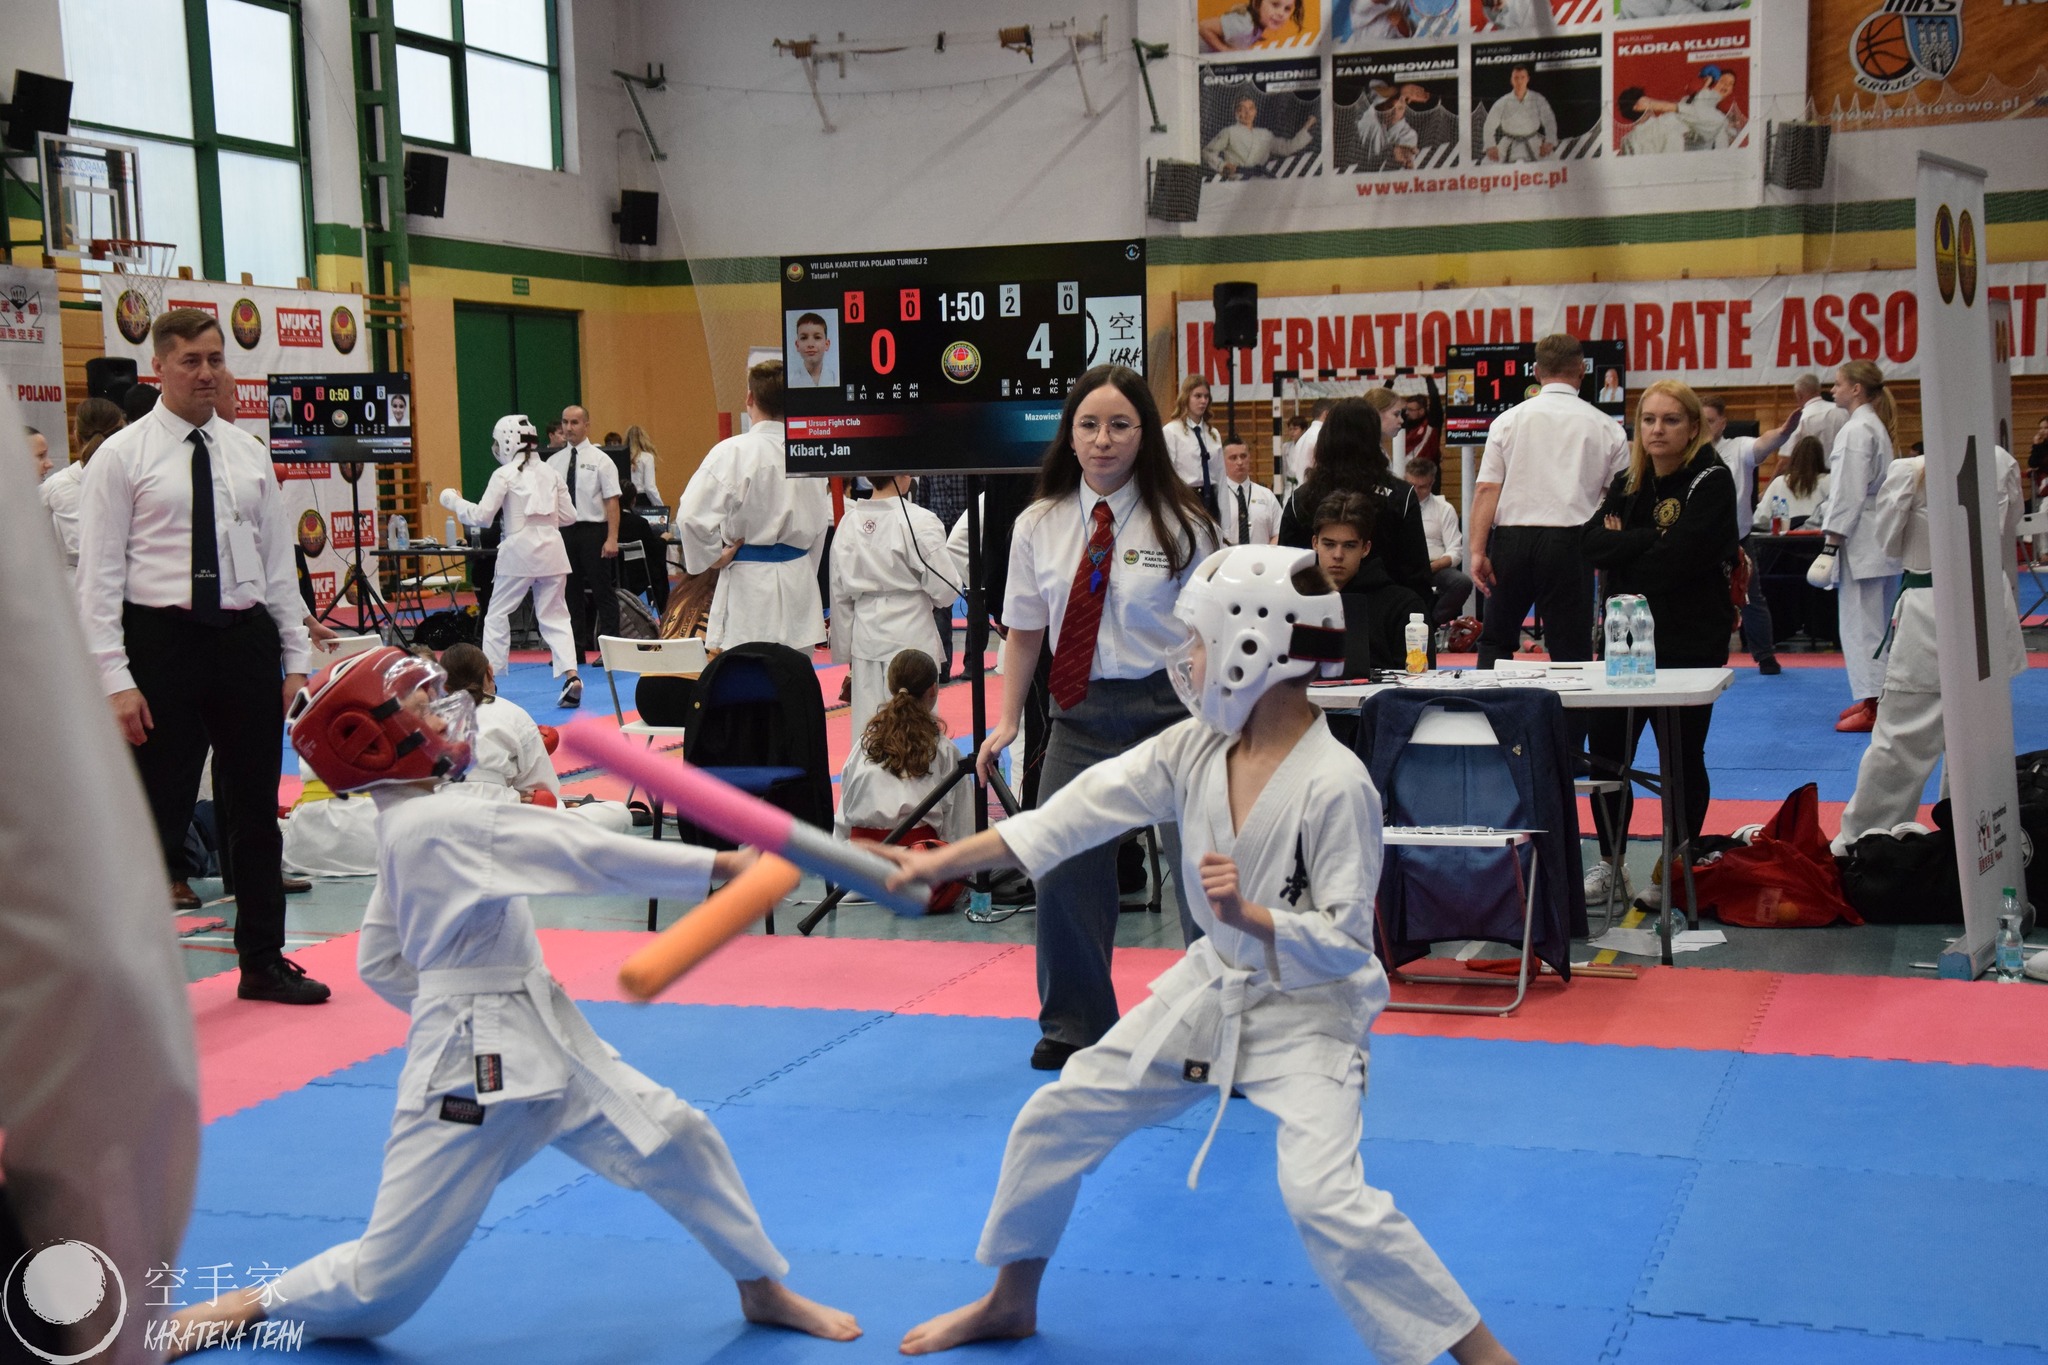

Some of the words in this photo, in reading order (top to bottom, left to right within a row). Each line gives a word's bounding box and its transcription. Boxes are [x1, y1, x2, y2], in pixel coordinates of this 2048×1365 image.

[1617, 41, 1681, 57] KADRA
[1683, 35, 1746, 51] KLUBU
[1336, 59, 1456, 77] ZAAWANSOWANI
[1831, 96, 2020, 122] www.parkietowo.pl
[1356, 166, 1569, 197] www.karategrojec.pl
[811, 262, 819, 270] VII
[835, 260, 858, 269] KARATE
[859, 260, 870, 268] IKA
[871, 259, 896, 267] POLAND
[897, 258, 923, 266] TURNIEJ
[923, 257, 928, 265] 2
[811, 272, 830, 280] Tatami
[850, 302, 859, 320] 0
[905, 300, 916, 318] 0
[938, 291, 985, 322] 1:50
[1005, 296, 1015, 314] 2
[1063, 293, 1074, 311] 0
[279, 312, 320, 330] WUKF
[871, 329, 896, 375] 0
[1026, 323, 1053, 369] 4
[1109, 346, 1141, 367] KARA
[1032, 387, 1041, 395] K2
[1050, 386, 1058, 394] KC
[1050, 378, 1058, 386] AC
[1066, 377, 1076, 385] AH
[1490, 378, 1500, 400] 1
[18, 384, 62, 402] POLAND
[237, 384, 268, 401] WUK
[329, 388, 350, 402] 0:50
[304, 402, 315, 422] 0
[364, 401, 376, 421] 0
[808, 428, 831, 436] Poland
[828, 419, 845, 428] Fight
[846, 418, 861, 426] Club
[790, 444, 827, 458] Kibart,
[830, 443, 851, 456] Jan
[1957, 435, 1991, 682] 1
